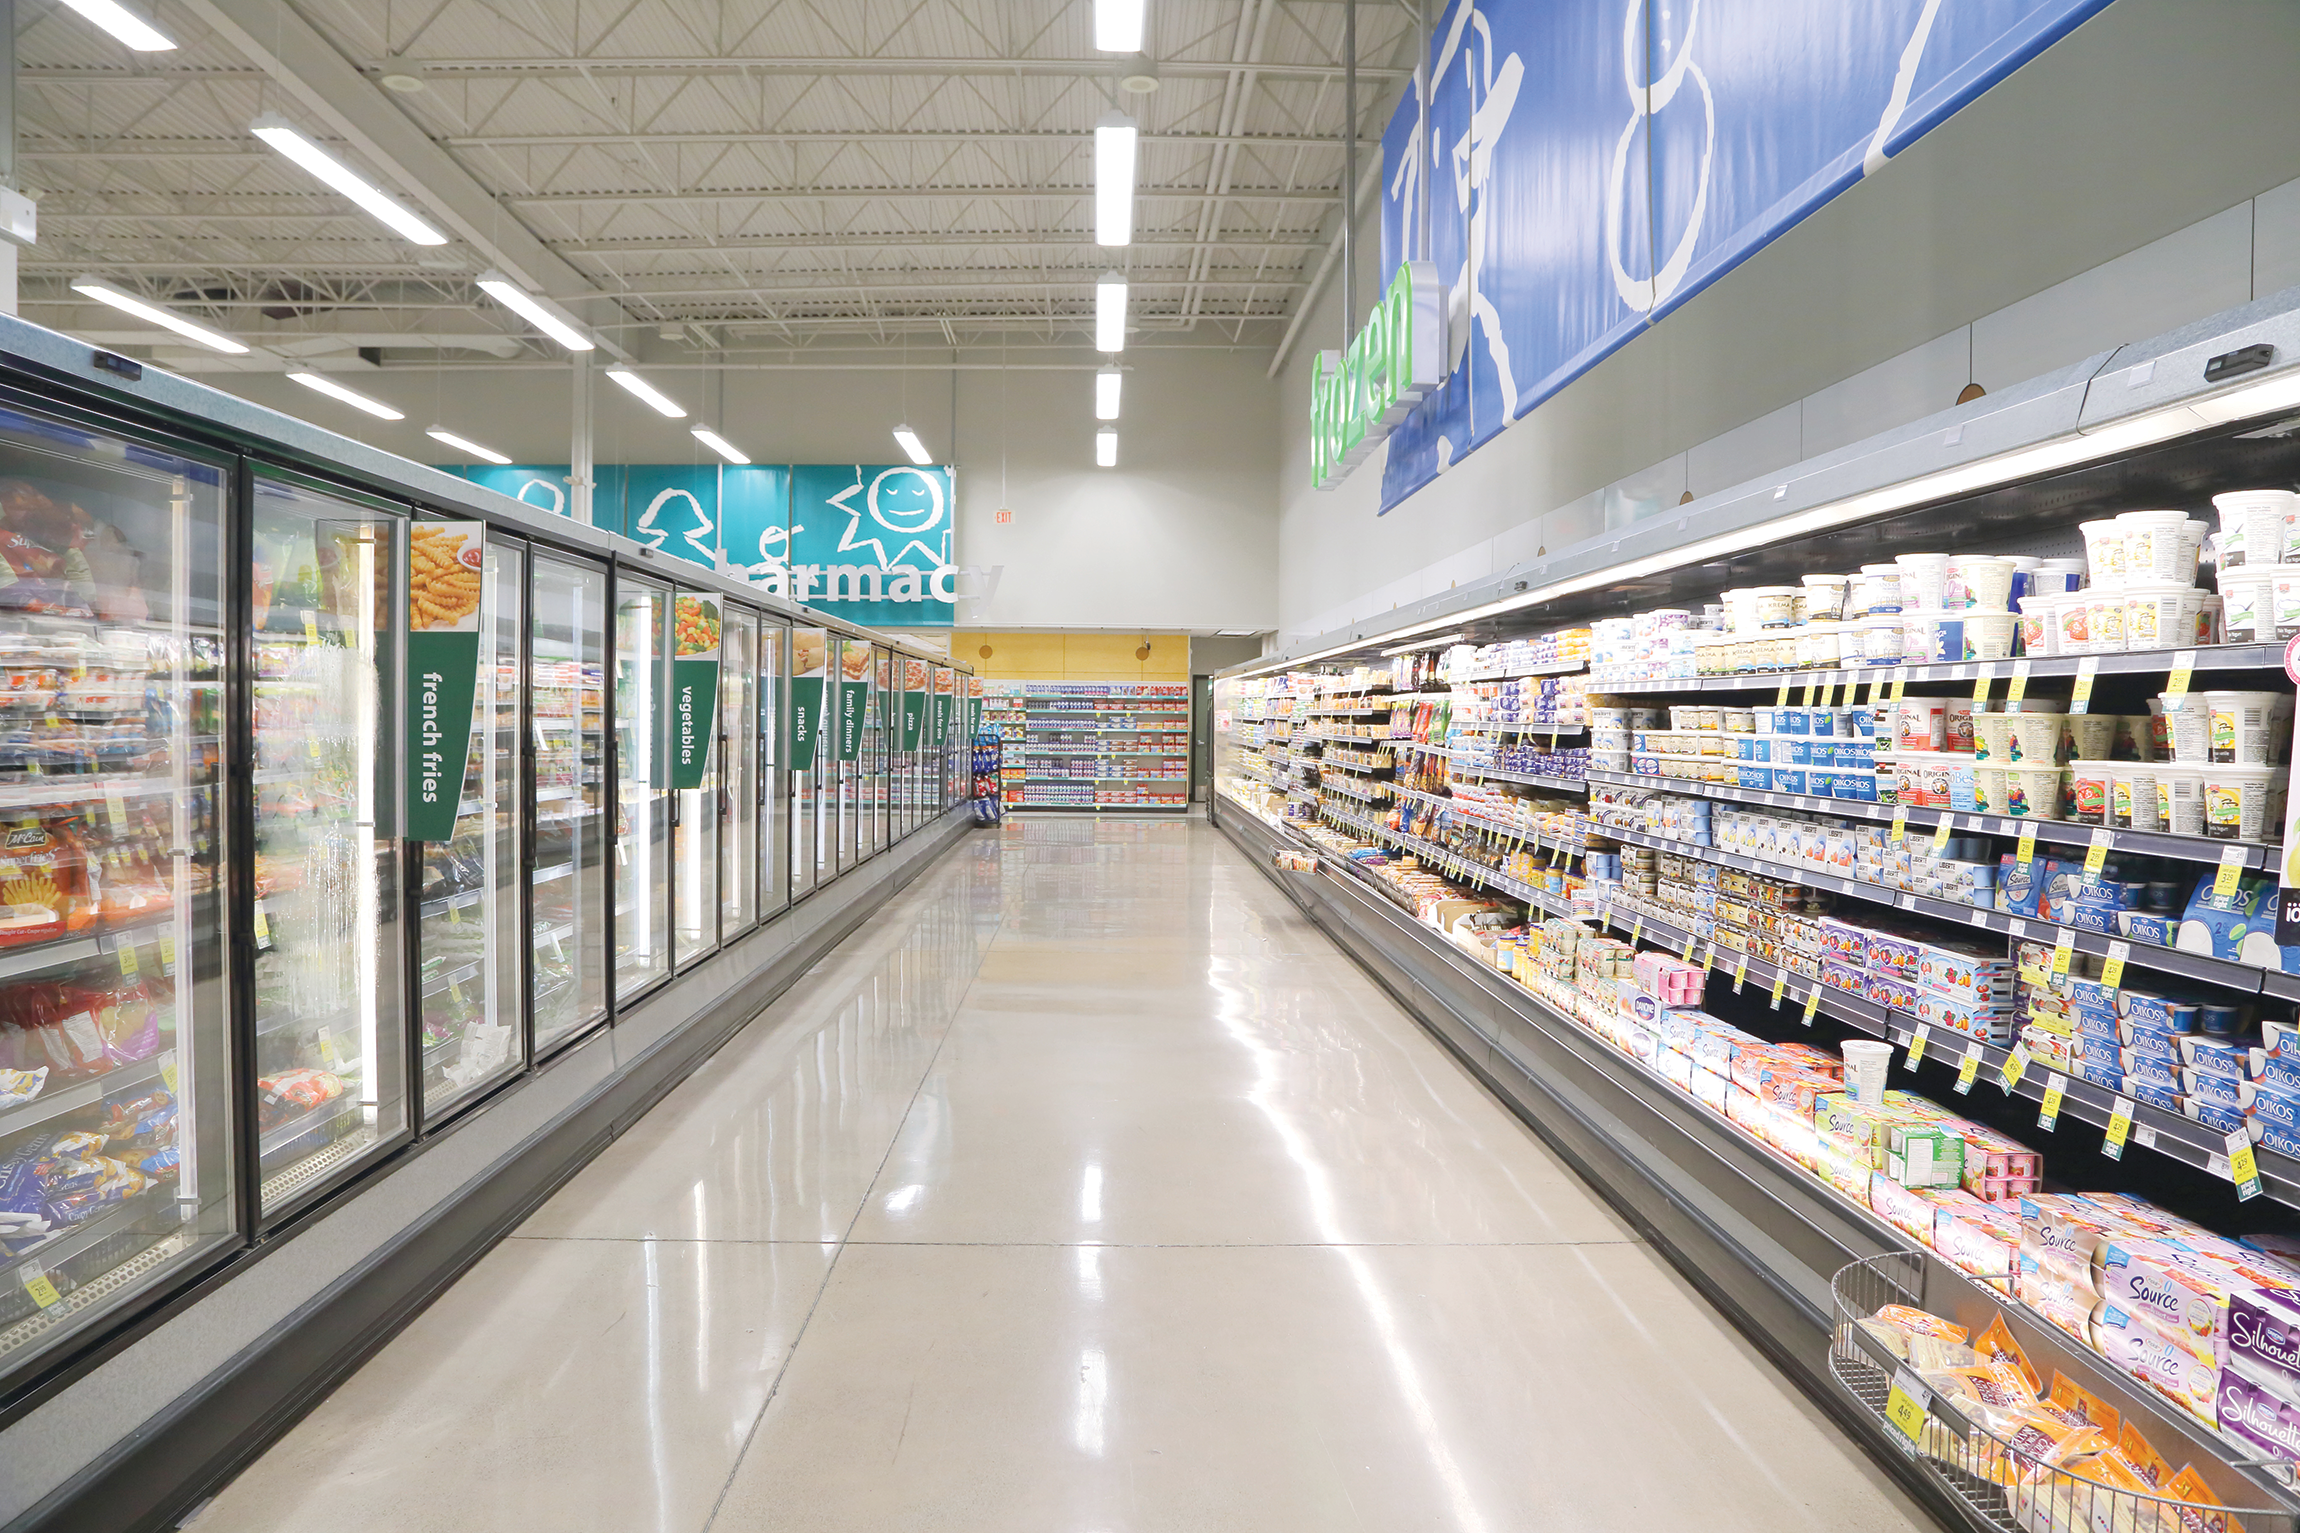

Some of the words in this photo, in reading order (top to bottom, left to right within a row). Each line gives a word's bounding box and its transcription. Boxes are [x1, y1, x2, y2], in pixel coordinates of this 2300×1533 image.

[1310, 261, 1413, 490] frozen
[996, 511, 1012, 523] EXIT
[714, 548, 1004, 618] harmacy
[421, 671, 443, 746] french
[845, 689, 856, 725] family
[678, 685, 696, 765] vegetables
[797, 706, 808, 742] snacks
[906, 712, 915, 731] pizza
[844, 724, 854, 753] dinners
[421, 751, 443, 803] fries
[1778, 773, 1799, 783] OIKOS
[1923, 769, 1950, 780] ORIGIN
[7, 831, 45, 846] McCain
[2009, 873, 2031, 885] Source
[2075, 911, 2105, 927] OIKOS
[2131, 921, 2161, 939] OIKOS
[1635, 997, 1655, 1014] DANONE
[2074, 988, 2105, 1006] OIKOS
[2081, 1016, 2109, 1034] OIKOS
[2084, 1044, 2112, 1062] OIKOS
[2085, 1070, 2115, 1089] OIKOS
[1772, 1084, 1797, 1103] Source
[2256, 1097, 2295, 1122] OIKOS
[1828, 1113, 1855, 1134] Source
[1829, 1156, 1852, 1179] Source
[2236, 1157, 2248, 1170] 429
[1886, 1196, 1913, 1220] Source
[2040, 1226, 2077, 1252] Source
[2038, 1281, 2075, 1309] Source
[2129, 1275, 2180, 1312] Source
[2127, 1337, 2180, 1376] Source
[1897, 1404, 1912, 1420] 449
[1882, 1420, 1900, 1443] priced
[1897, 1433, 1917, 1454] right
